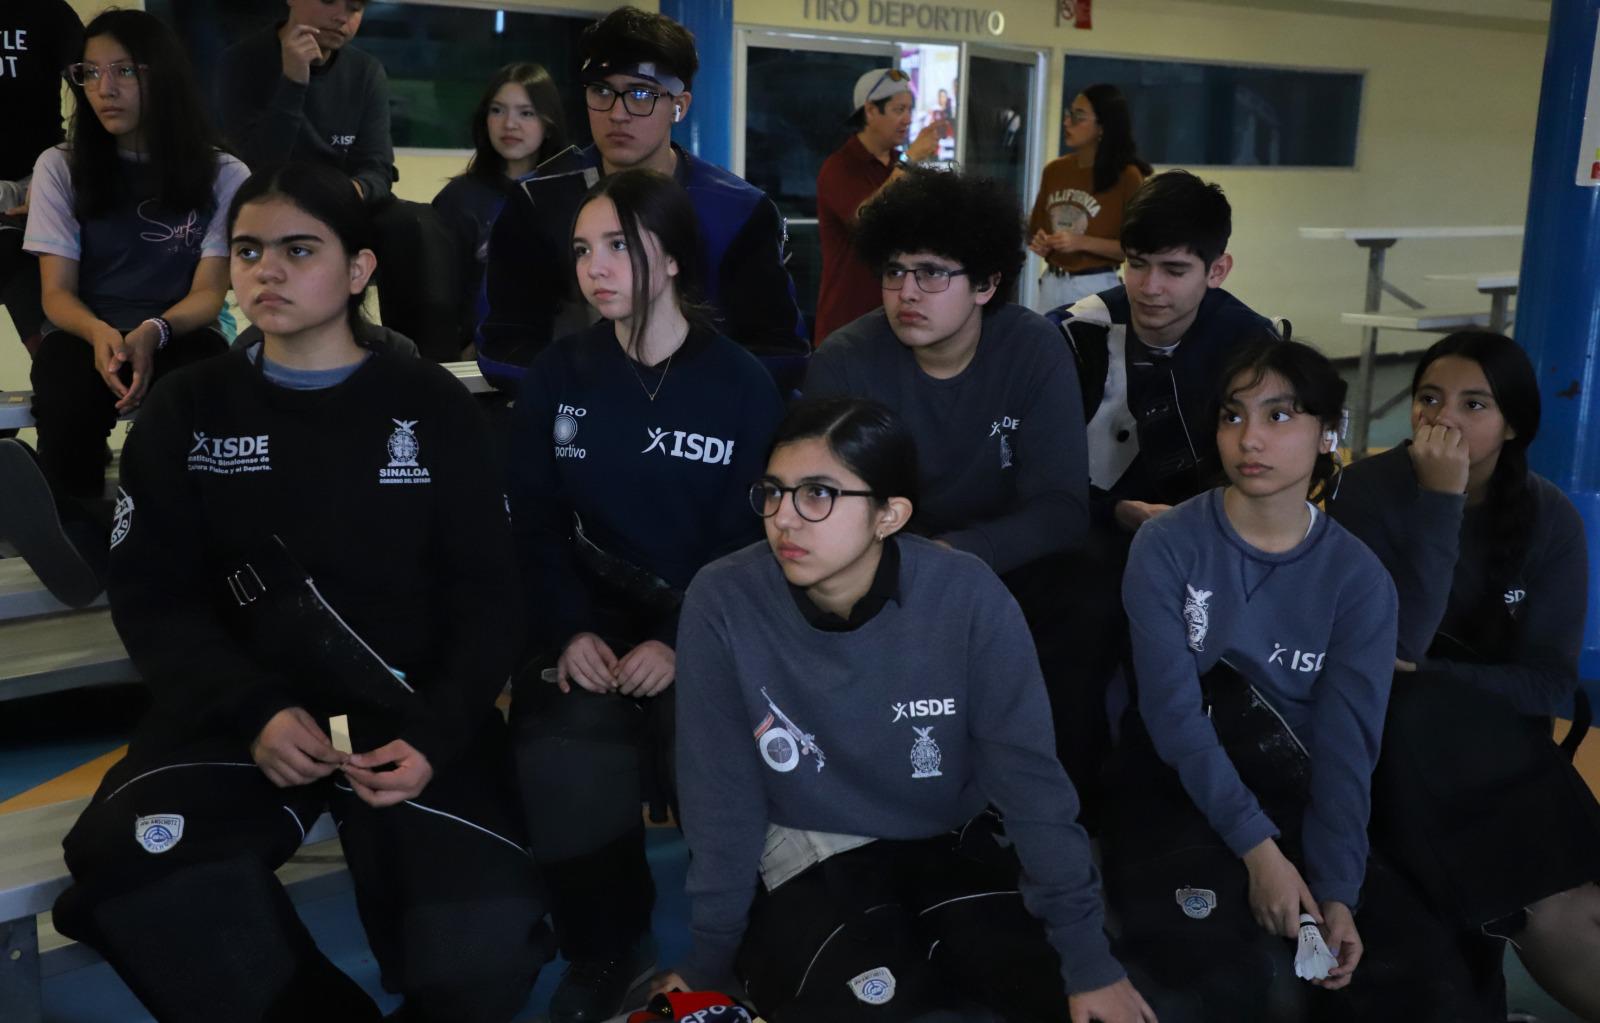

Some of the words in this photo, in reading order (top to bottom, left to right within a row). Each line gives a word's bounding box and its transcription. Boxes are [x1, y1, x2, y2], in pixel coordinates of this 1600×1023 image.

[867, 0, 1005, 36] DEPORTIVO
[0, 29, 28, 50] LE
[1046, 188, 1101, 217] ALIFORNIA
[212, 435, 269, 457] ISDE
[379, 467, 430, 477] SINALOA
[910, 698, 956, 717] ISDE
